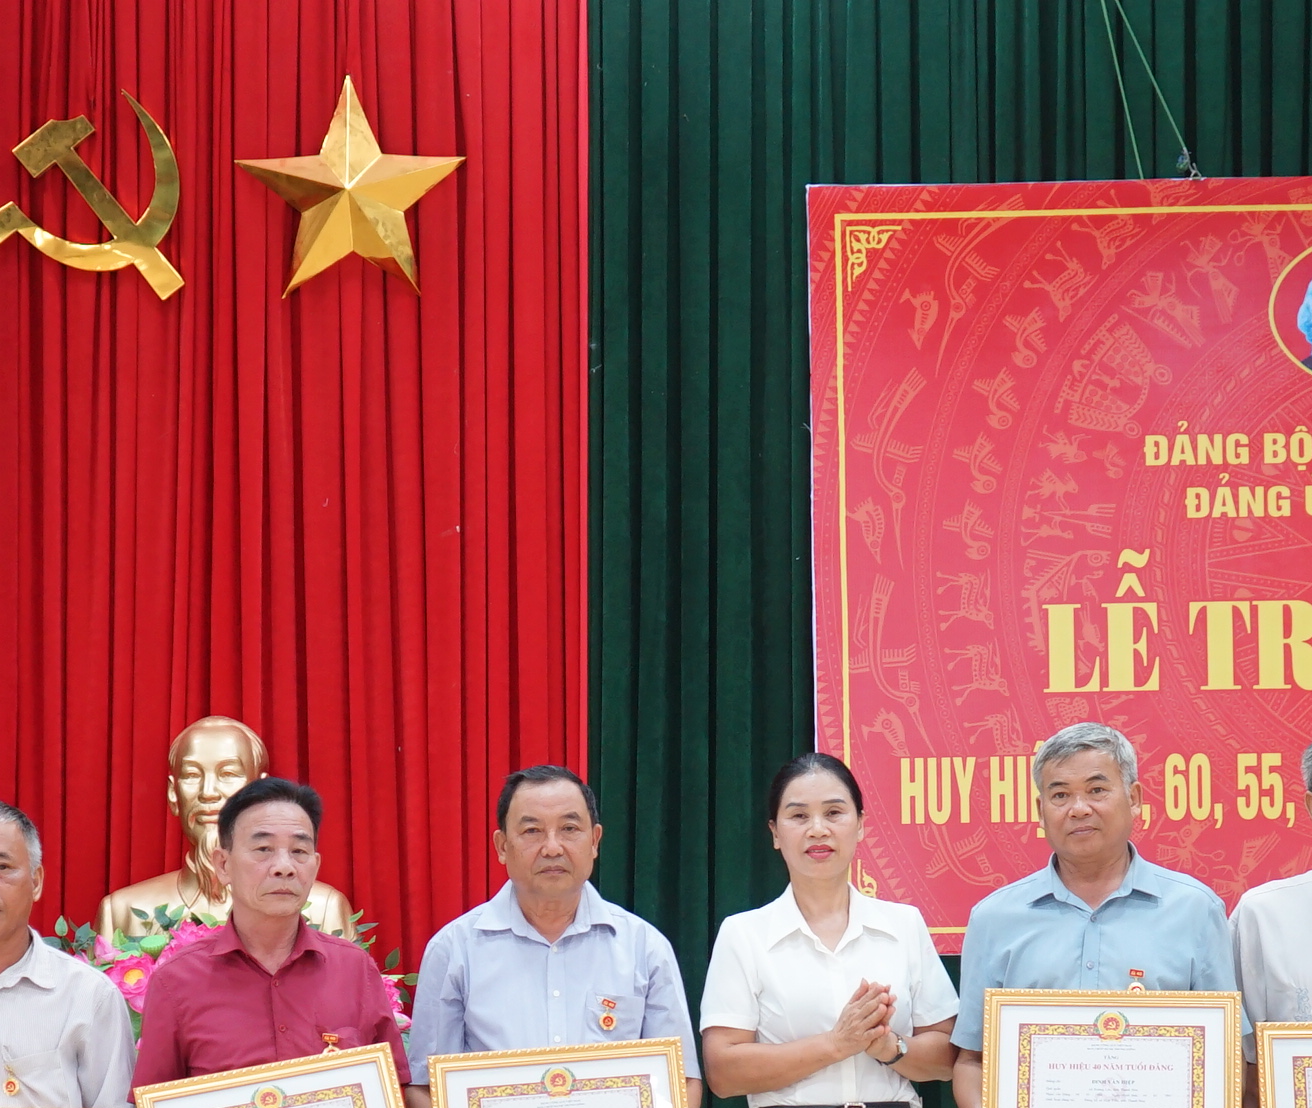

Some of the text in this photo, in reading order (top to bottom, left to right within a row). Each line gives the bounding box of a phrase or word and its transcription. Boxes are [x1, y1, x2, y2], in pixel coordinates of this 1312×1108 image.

[1144, 420, 1249, 466] ĐẢNG
[1185, 473, 1290, 518] ĐẢNG
[1042, 548, 1161, 694] LỄ
[900, 756, 976, 825] HUY
[1164, 753, 1223, 829] 60,
[1237, 752, 1296, 828] 55,
[1070, 1063, 1091, 1072] HIỆU
[1125, 1061, 1146, 1071] TUỔI
[1148, 1063, 1174, 1071] ĐẢNG
